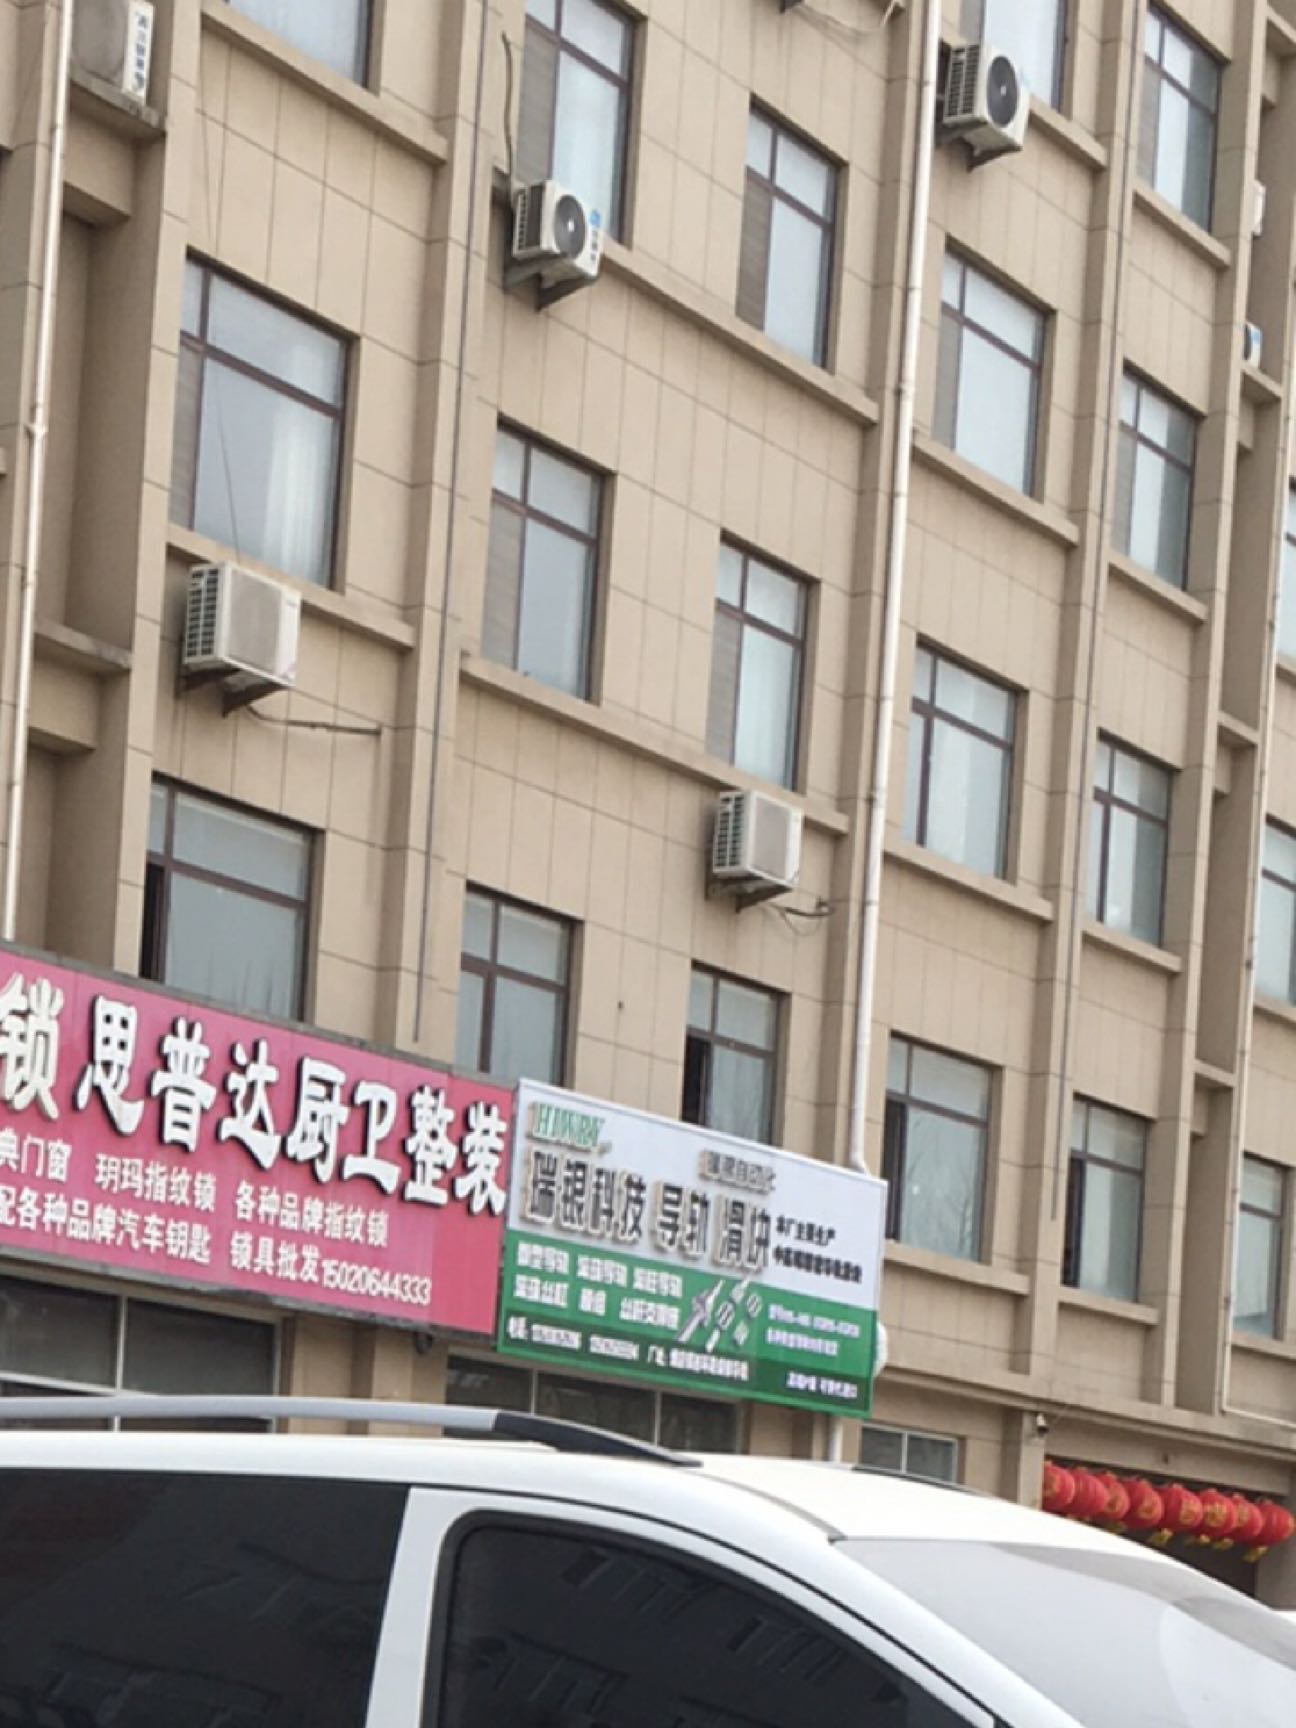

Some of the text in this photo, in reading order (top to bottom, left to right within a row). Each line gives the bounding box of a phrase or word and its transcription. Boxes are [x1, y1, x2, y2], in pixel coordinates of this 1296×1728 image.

[74, 994, 507, 1216] 思普达厨卫整装
[94, 1152, 217, 1212] 玥玛指纹锁
[234, 1180, 389, 1248] 各种品牌指纹锁
